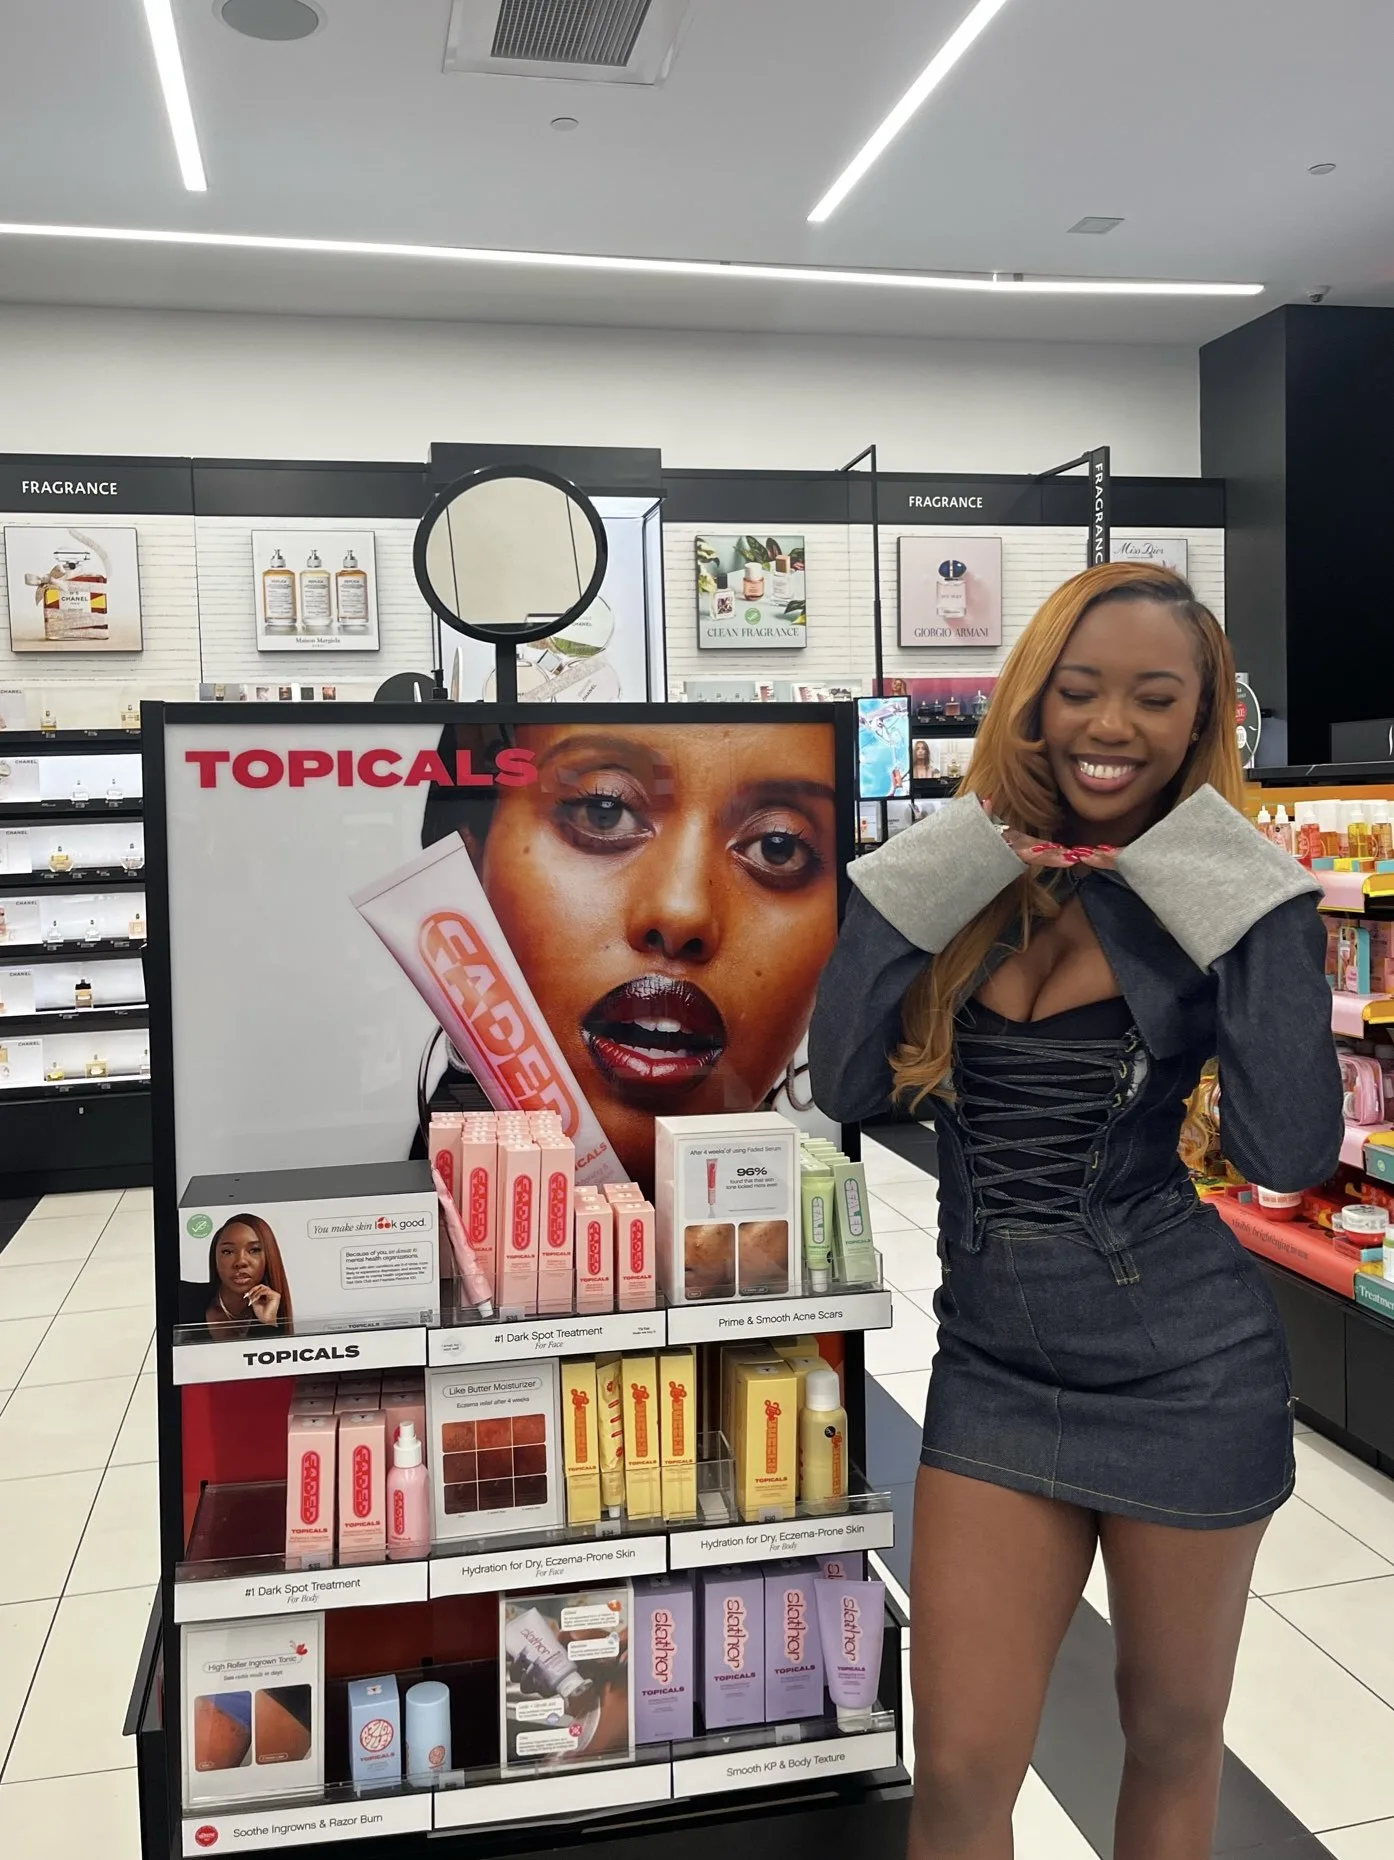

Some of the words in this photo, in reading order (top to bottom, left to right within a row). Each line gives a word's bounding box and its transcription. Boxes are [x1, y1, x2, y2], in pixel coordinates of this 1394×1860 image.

[21, 480, 118, 495] FRAGRANCE
[908, 495, 983, 508] FRAGRANCE
[1095, 463, 1103, 563] FRAGRANC
[1113, 542, 1140, 554] Miss
[1140, 542, 1164, 555] Dior
[707, 627, 738, 638] CLEAN
[741, 627, 799, 637] FRAGRANCE
[914, 627, 951, 638] GIORGIO
[955, 627, 988, 638] ARMANI
[185, 748, 539, 790] TOPICALS
[575, 1141, 607, 1172] ICALS
[736, 1167, 768, 1176] 96%
[313, 1225, 329, 1234] You
[331, 1223, 354, 1233] make
[355, 1222, 372, 1231] skin
[1252, 1225, 1291, 1253] brightening
[718, 1317, 744, 1327] Prime
[746, 1316, 754, 1326] &
[755, 1313, 791, 1325] Smooth
[792, 1311, 816, 1322] Acne
[818, 1309, 843, 1320] Scars
[494, 1334, 504, 1343] #1
[507, 1331, 529, 1342] Dark
[531, 1330, 554, 1342] Spot
[556, 1327, 603, 1338] Treatment
[534, 1342, 547, 1350] For
[548, 1341, 564, 1349] Face
[243, 1345, 360, 1366] TOPICALS
[449, 1387, 466, 1395] Like
[467, 1385, 491, 1394] Butter
[493, 1381, 536, 1391] Moisturizer
[701, 1537, 743, 1550] Hydration
[746, 1534, 758, 1543] for
[760, 1533, 777, 1545] Dry,
[780, 1526, 844, 1541] Eczema-Prone
[846, 1524, 865, 1534] Skin
[782, 1542, 797, 1551] Body
[461, 1563, 507, 1577] Hydration
[509, 1561, 522, 1570] for
[525, 1559, 543, 1570] Dry,
[545, 1552, 613, 1566] Eczema-Prone
[616, 1549, 635, 1558] Skin
[548, 1568, 564, 1576] Face
[245, 1587, 255, 1597] #1
[258, 1585, 282, 1596] Dark
[284, 1583, 308, 1595] Spot
[311, 1578, 361, 1591] Treatment
[287, 1595, 299, 1604] For
[301, 1593, 319, 1604] Body
[208, 1664, 225, 1672] High
[249, 1658, 277, 1668] Ingrown
[774, 1664, 816, 1675] TOPICALS
[714, 1672, 756, 1682] TOPICALS
[642, 1686, 685, 1696] TOPICALS
[360, 1752, 395, 1762] TOPICALS
[726, 1764, 762, 1777] Smooth
[763, 1762, 777, 1772] KP
[779, 1760, 786, 1769] &
[788, 1756, 812, 1769] Body
[814, 1753, 845, 1765] Texture
[233, 1826, 268, 1838] Soothe
[271, 1821, 316, 1835] Ingrowns
[319, 1819, 327, 1829] &
[329, 1816, 358, 1828] Razor
[360, 1813, 383, 1824] Burn
